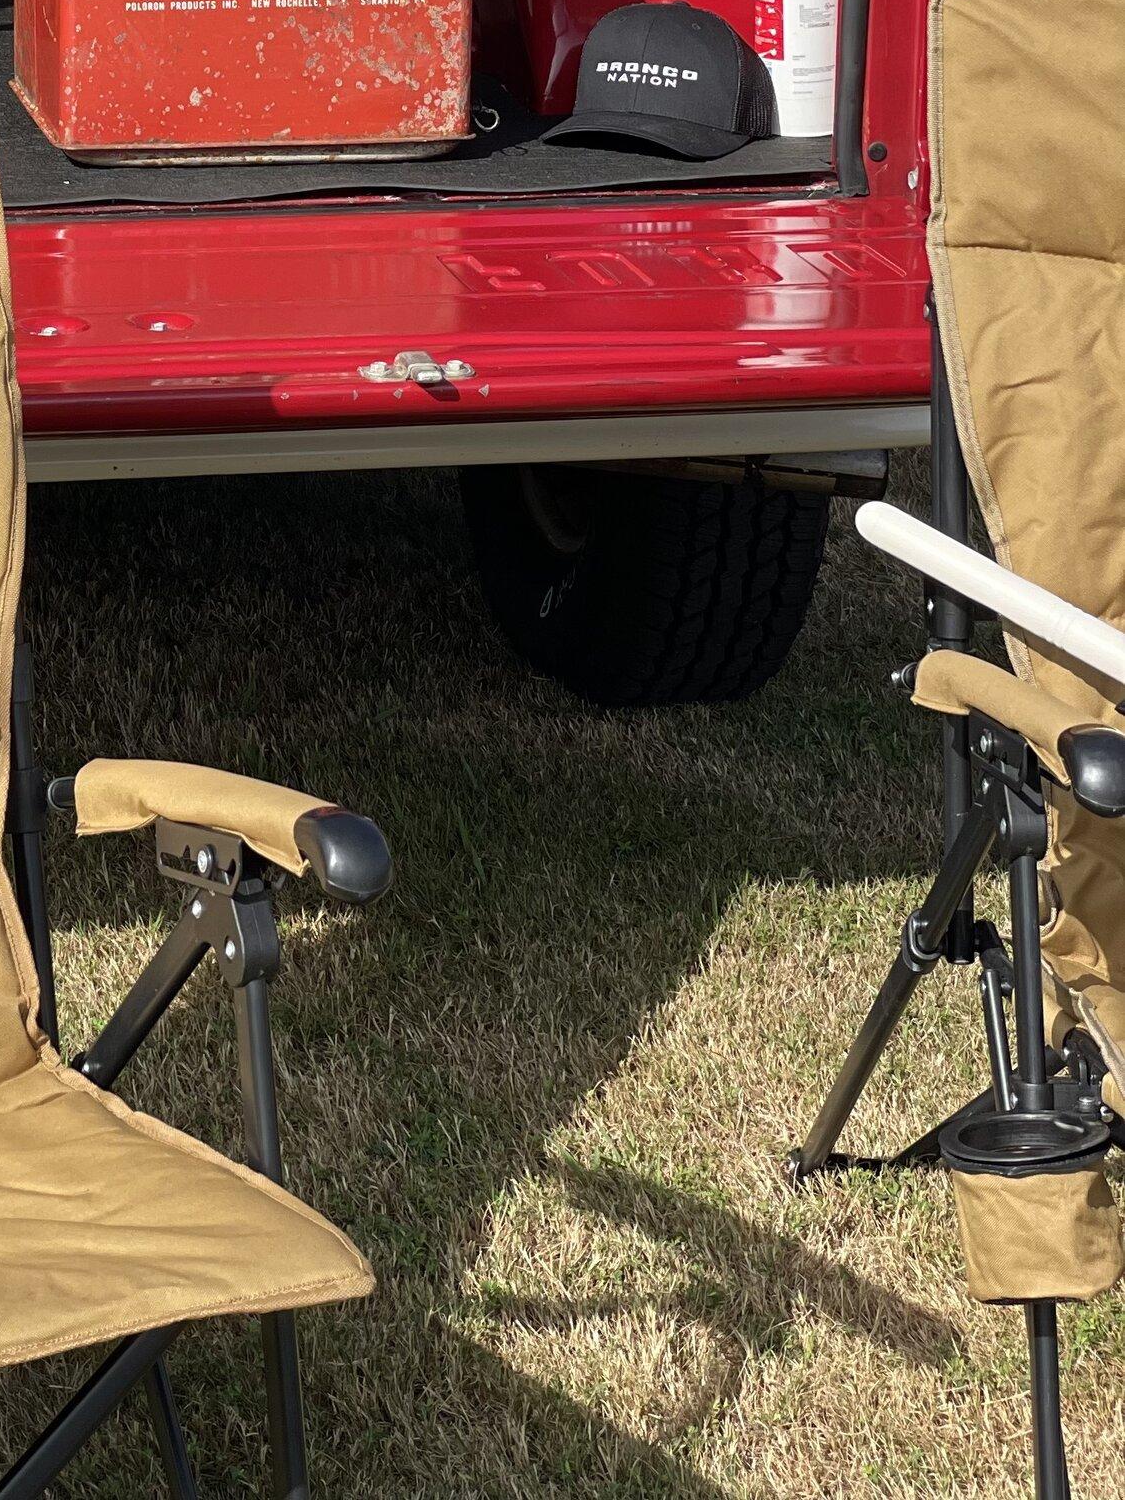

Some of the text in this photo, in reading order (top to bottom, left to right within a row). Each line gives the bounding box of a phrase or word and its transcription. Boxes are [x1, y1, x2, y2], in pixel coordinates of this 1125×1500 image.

[125, 1, 165, 11] POLORON
[170, 0, 216, 11] PRODUCTS
[251, 0, 271, 9] NEW
[595, 61, 698, 81] BRONCO
[606, 72, 678, 88] NATION
